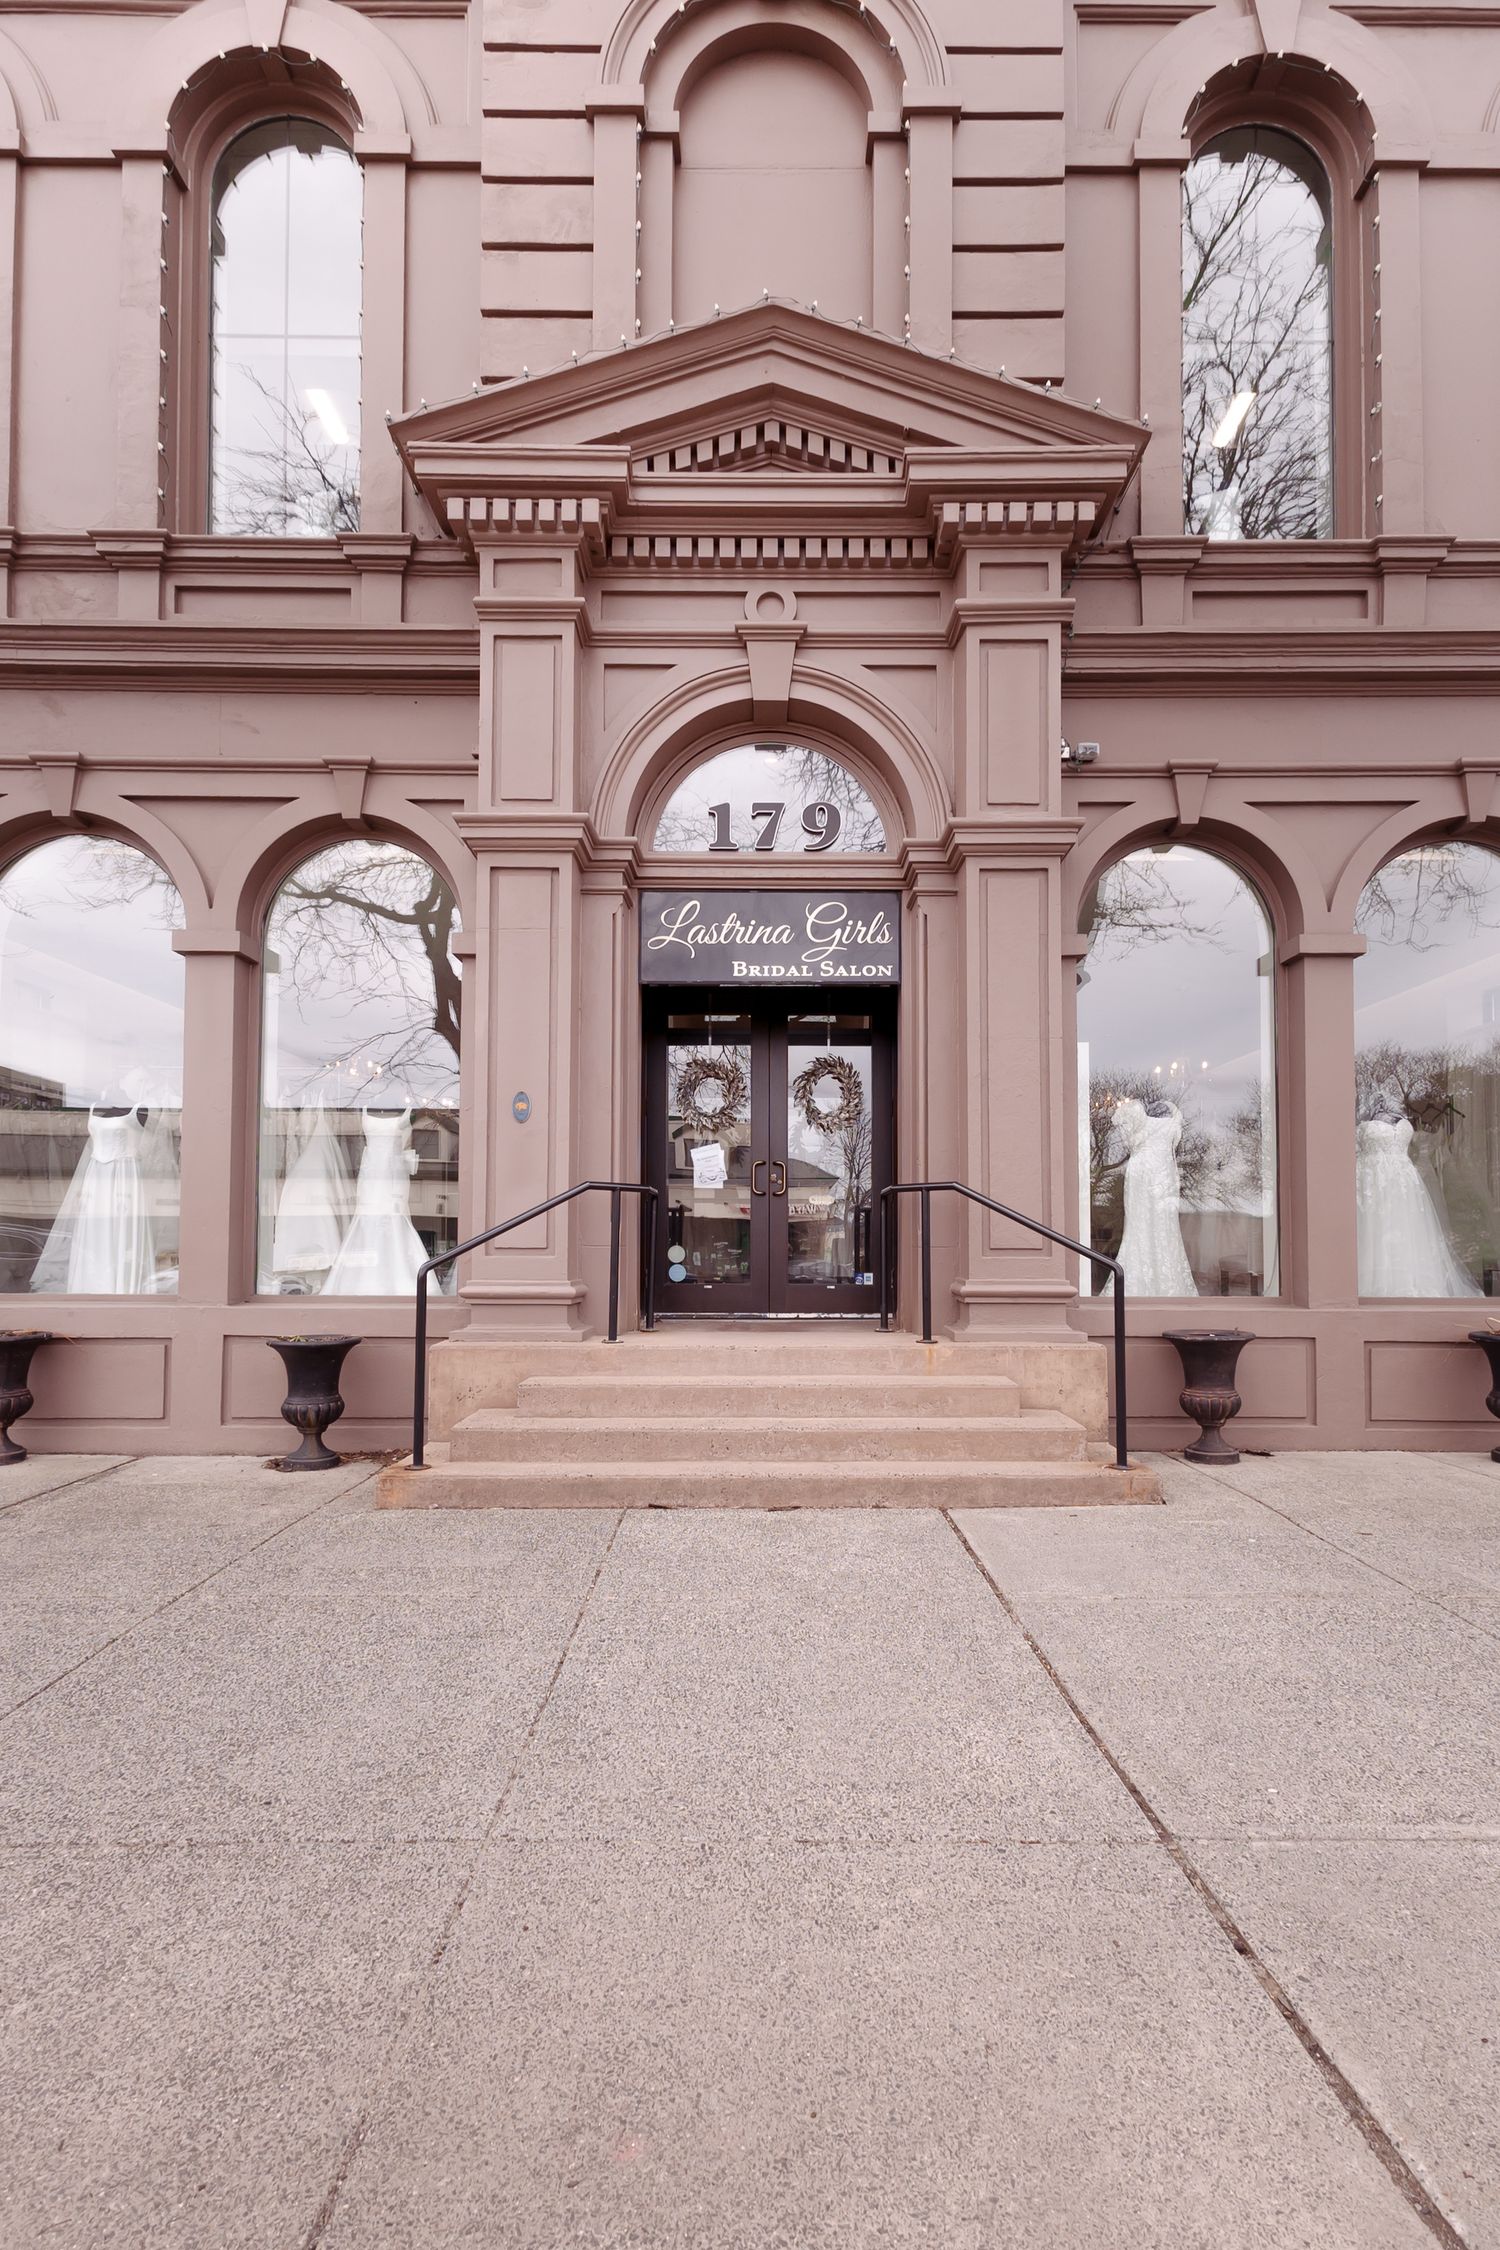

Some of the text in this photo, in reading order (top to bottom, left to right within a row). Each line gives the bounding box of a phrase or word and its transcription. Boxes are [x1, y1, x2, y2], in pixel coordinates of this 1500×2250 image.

[708, 802, 842, 851] 179
[647, 900, 894, 962] Lastrina Girls
[732, 961, 893, 977] BRIDAL SALON
